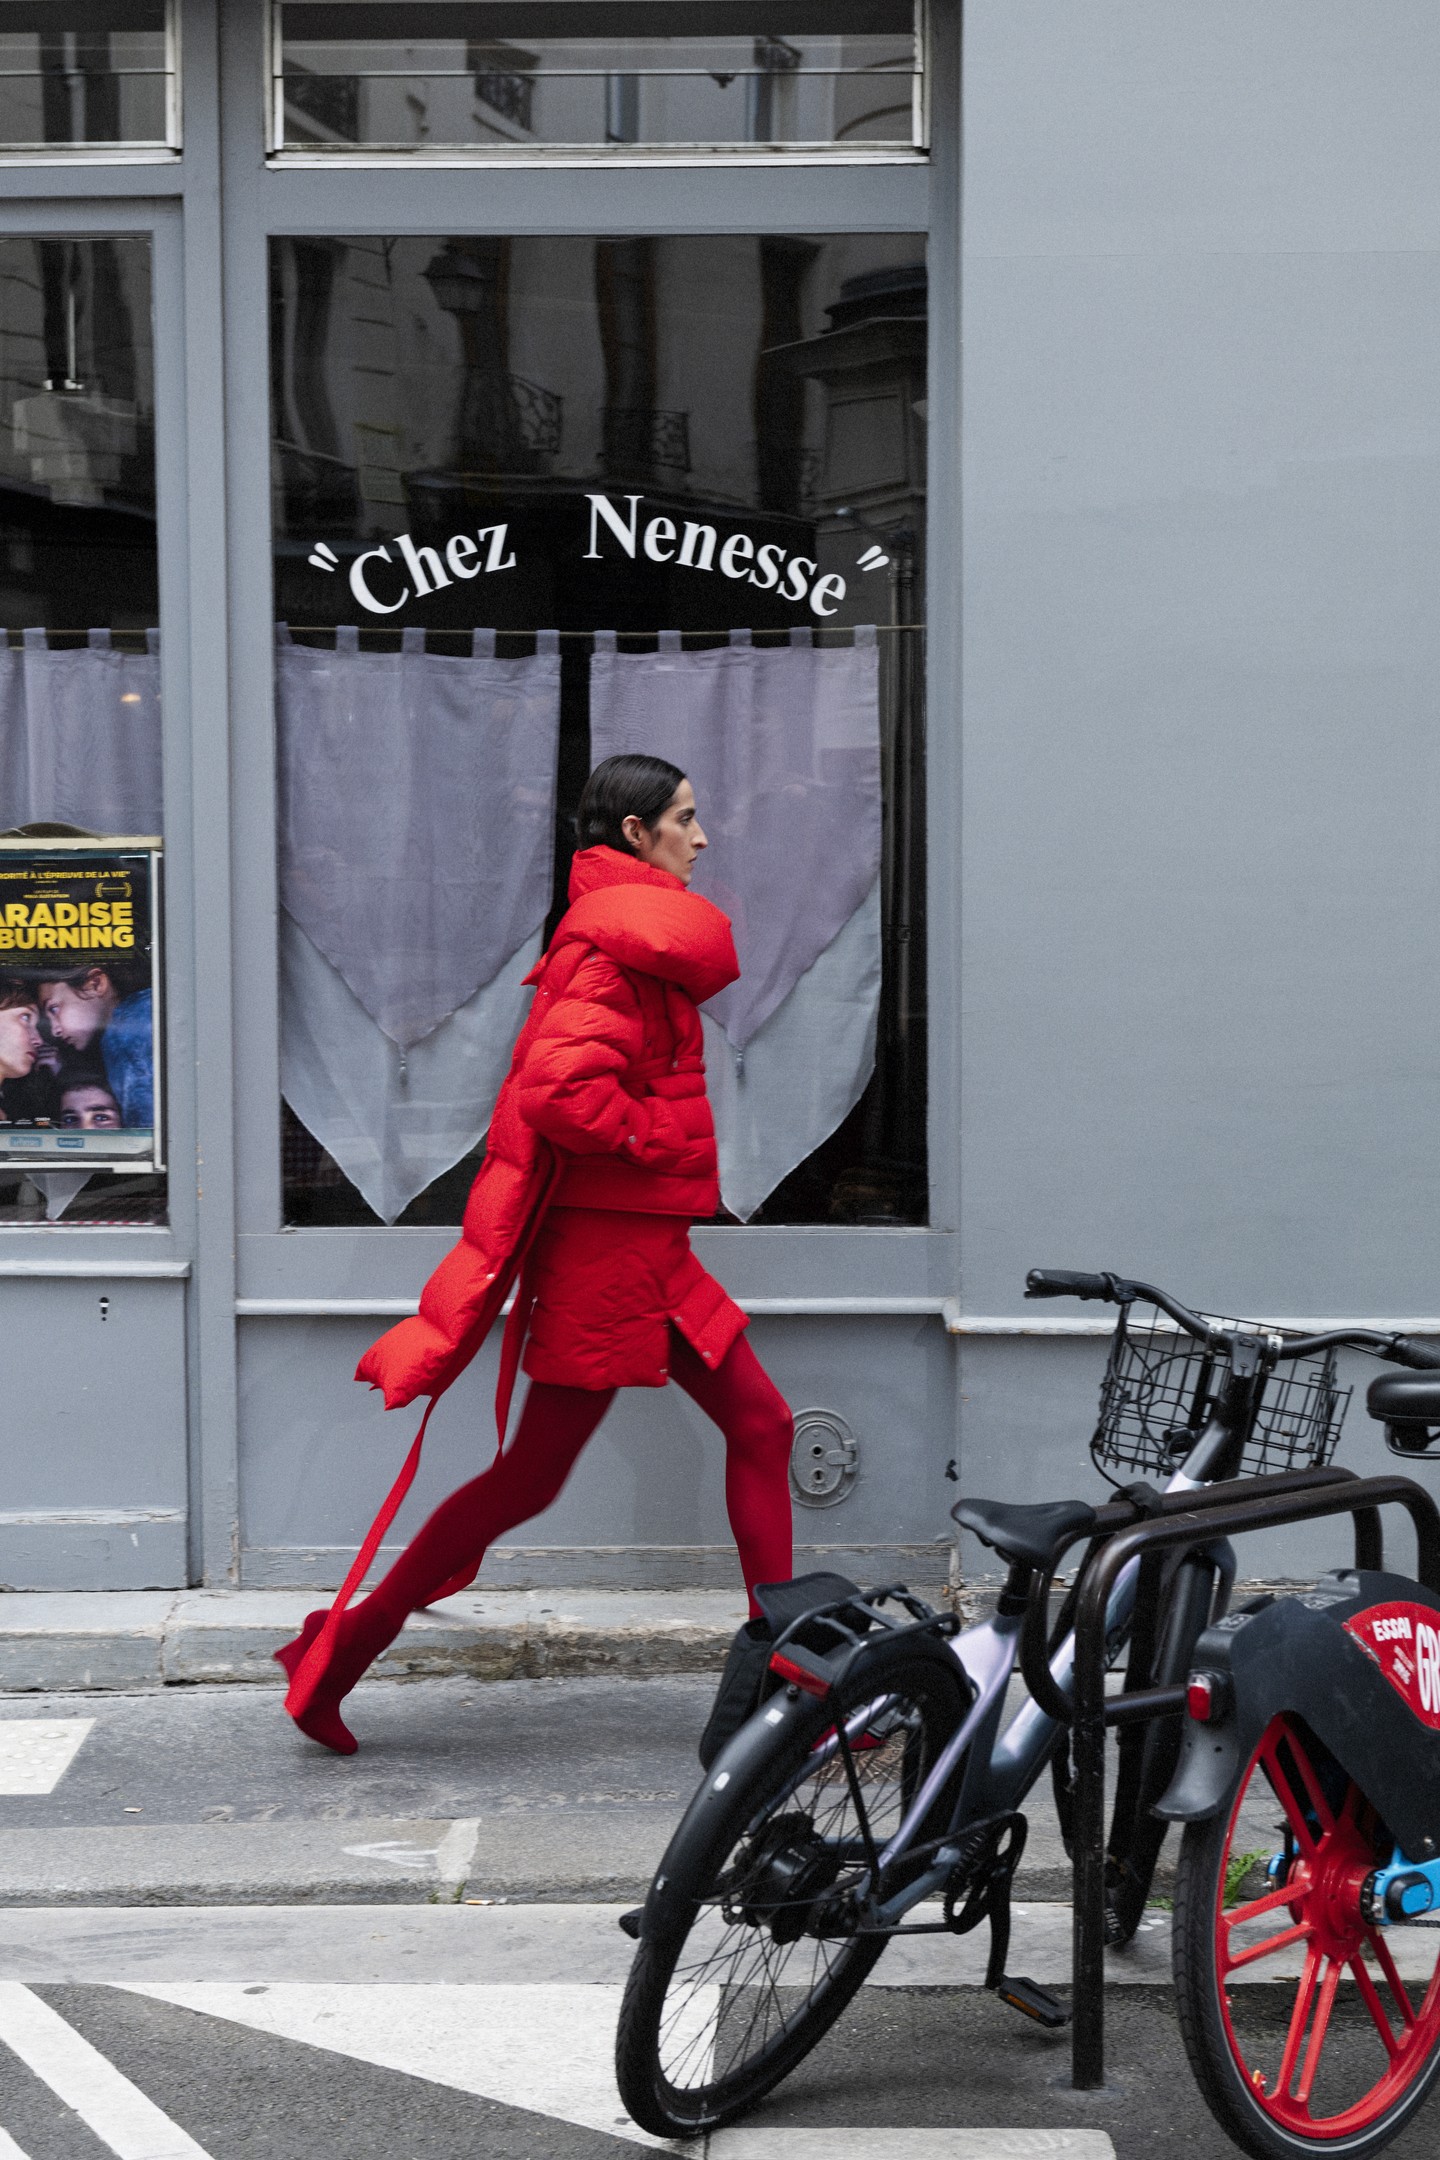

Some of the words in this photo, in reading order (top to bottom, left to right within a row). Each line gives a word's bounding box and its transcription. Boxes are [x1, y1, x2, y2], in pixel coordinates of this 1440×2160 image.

[85, 871, 98, 879] DE
[99, 871, 111, 879] LA
[0, 902, 134, 926] RADISE
[0, 926, 135, 949] BURNING
[1372, 1617, 1412, 1641] ESSAI
[1416, 1622, 1440, 1714] GR
